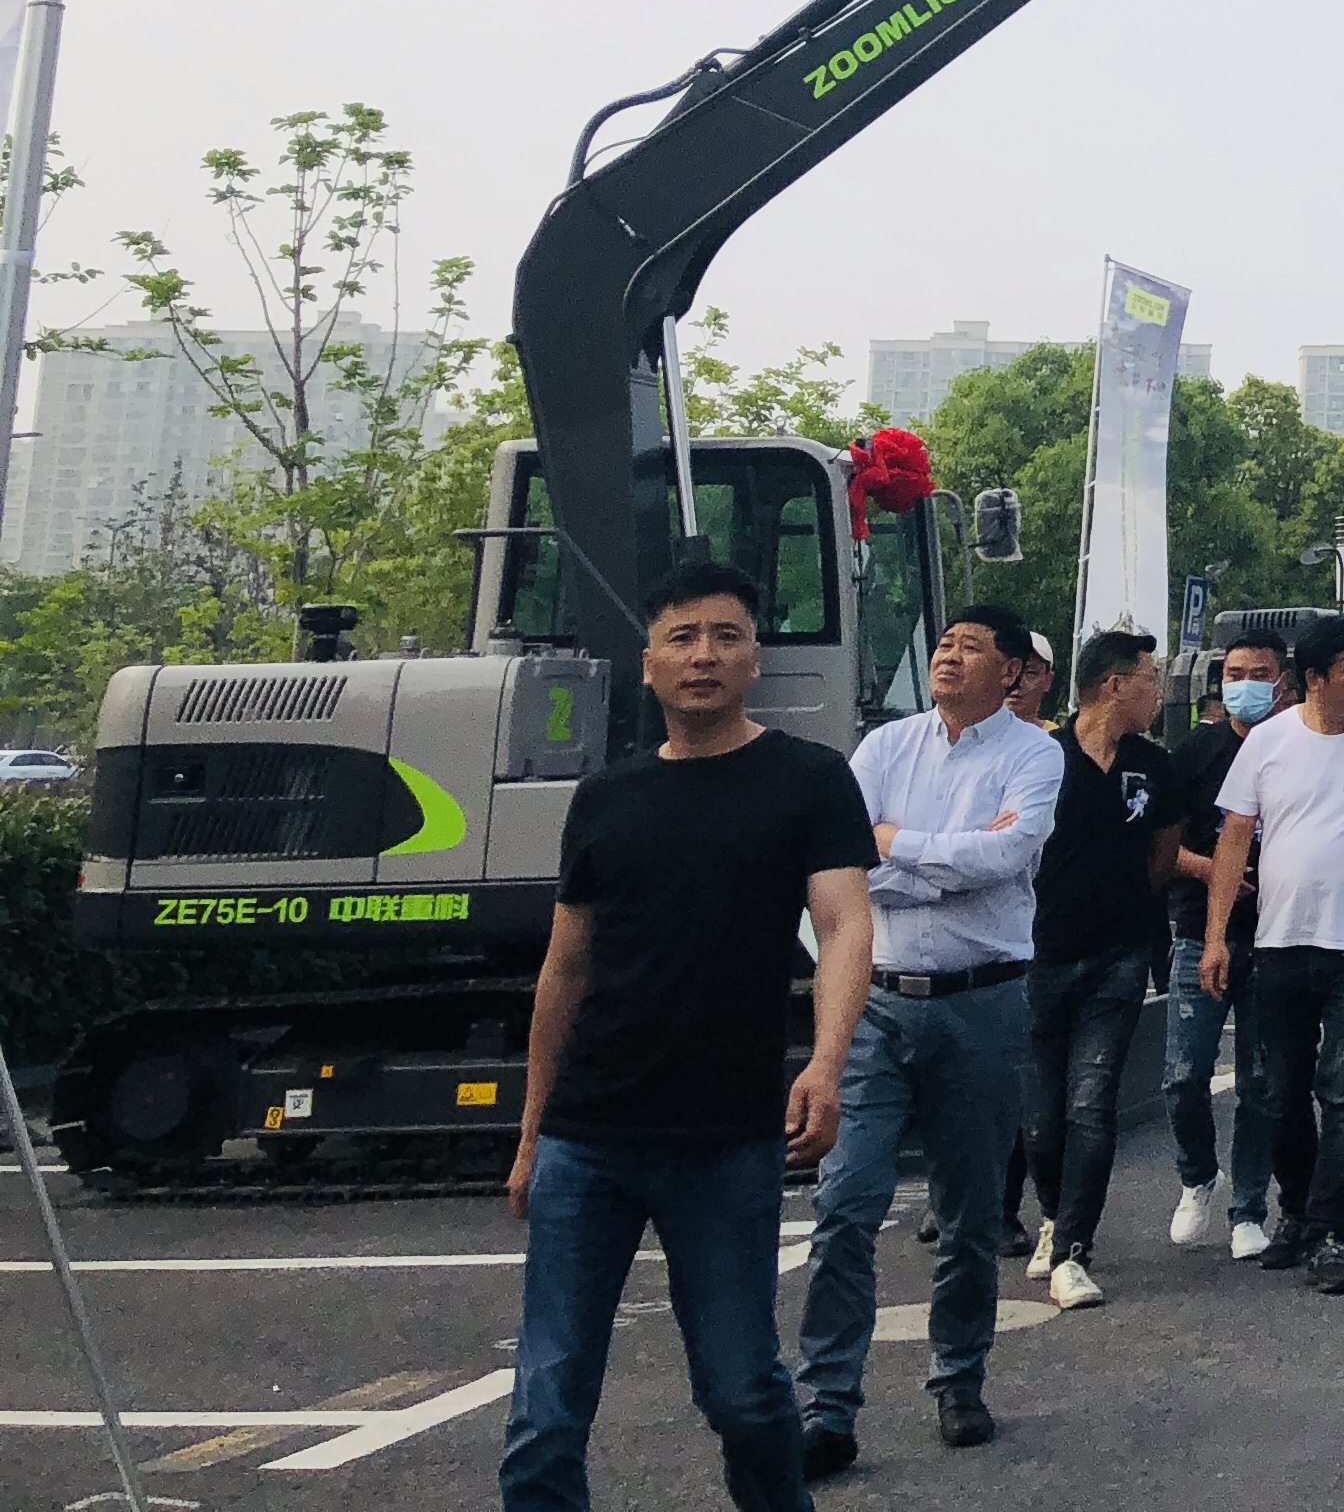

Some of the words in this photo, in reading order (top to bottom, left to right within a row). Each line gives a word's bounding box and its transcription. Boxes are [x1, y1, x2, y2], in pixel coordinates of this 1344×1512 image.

[153, 896, 309, 926] ZE75E-10
[328, 892, 470, 923] 中联重科
